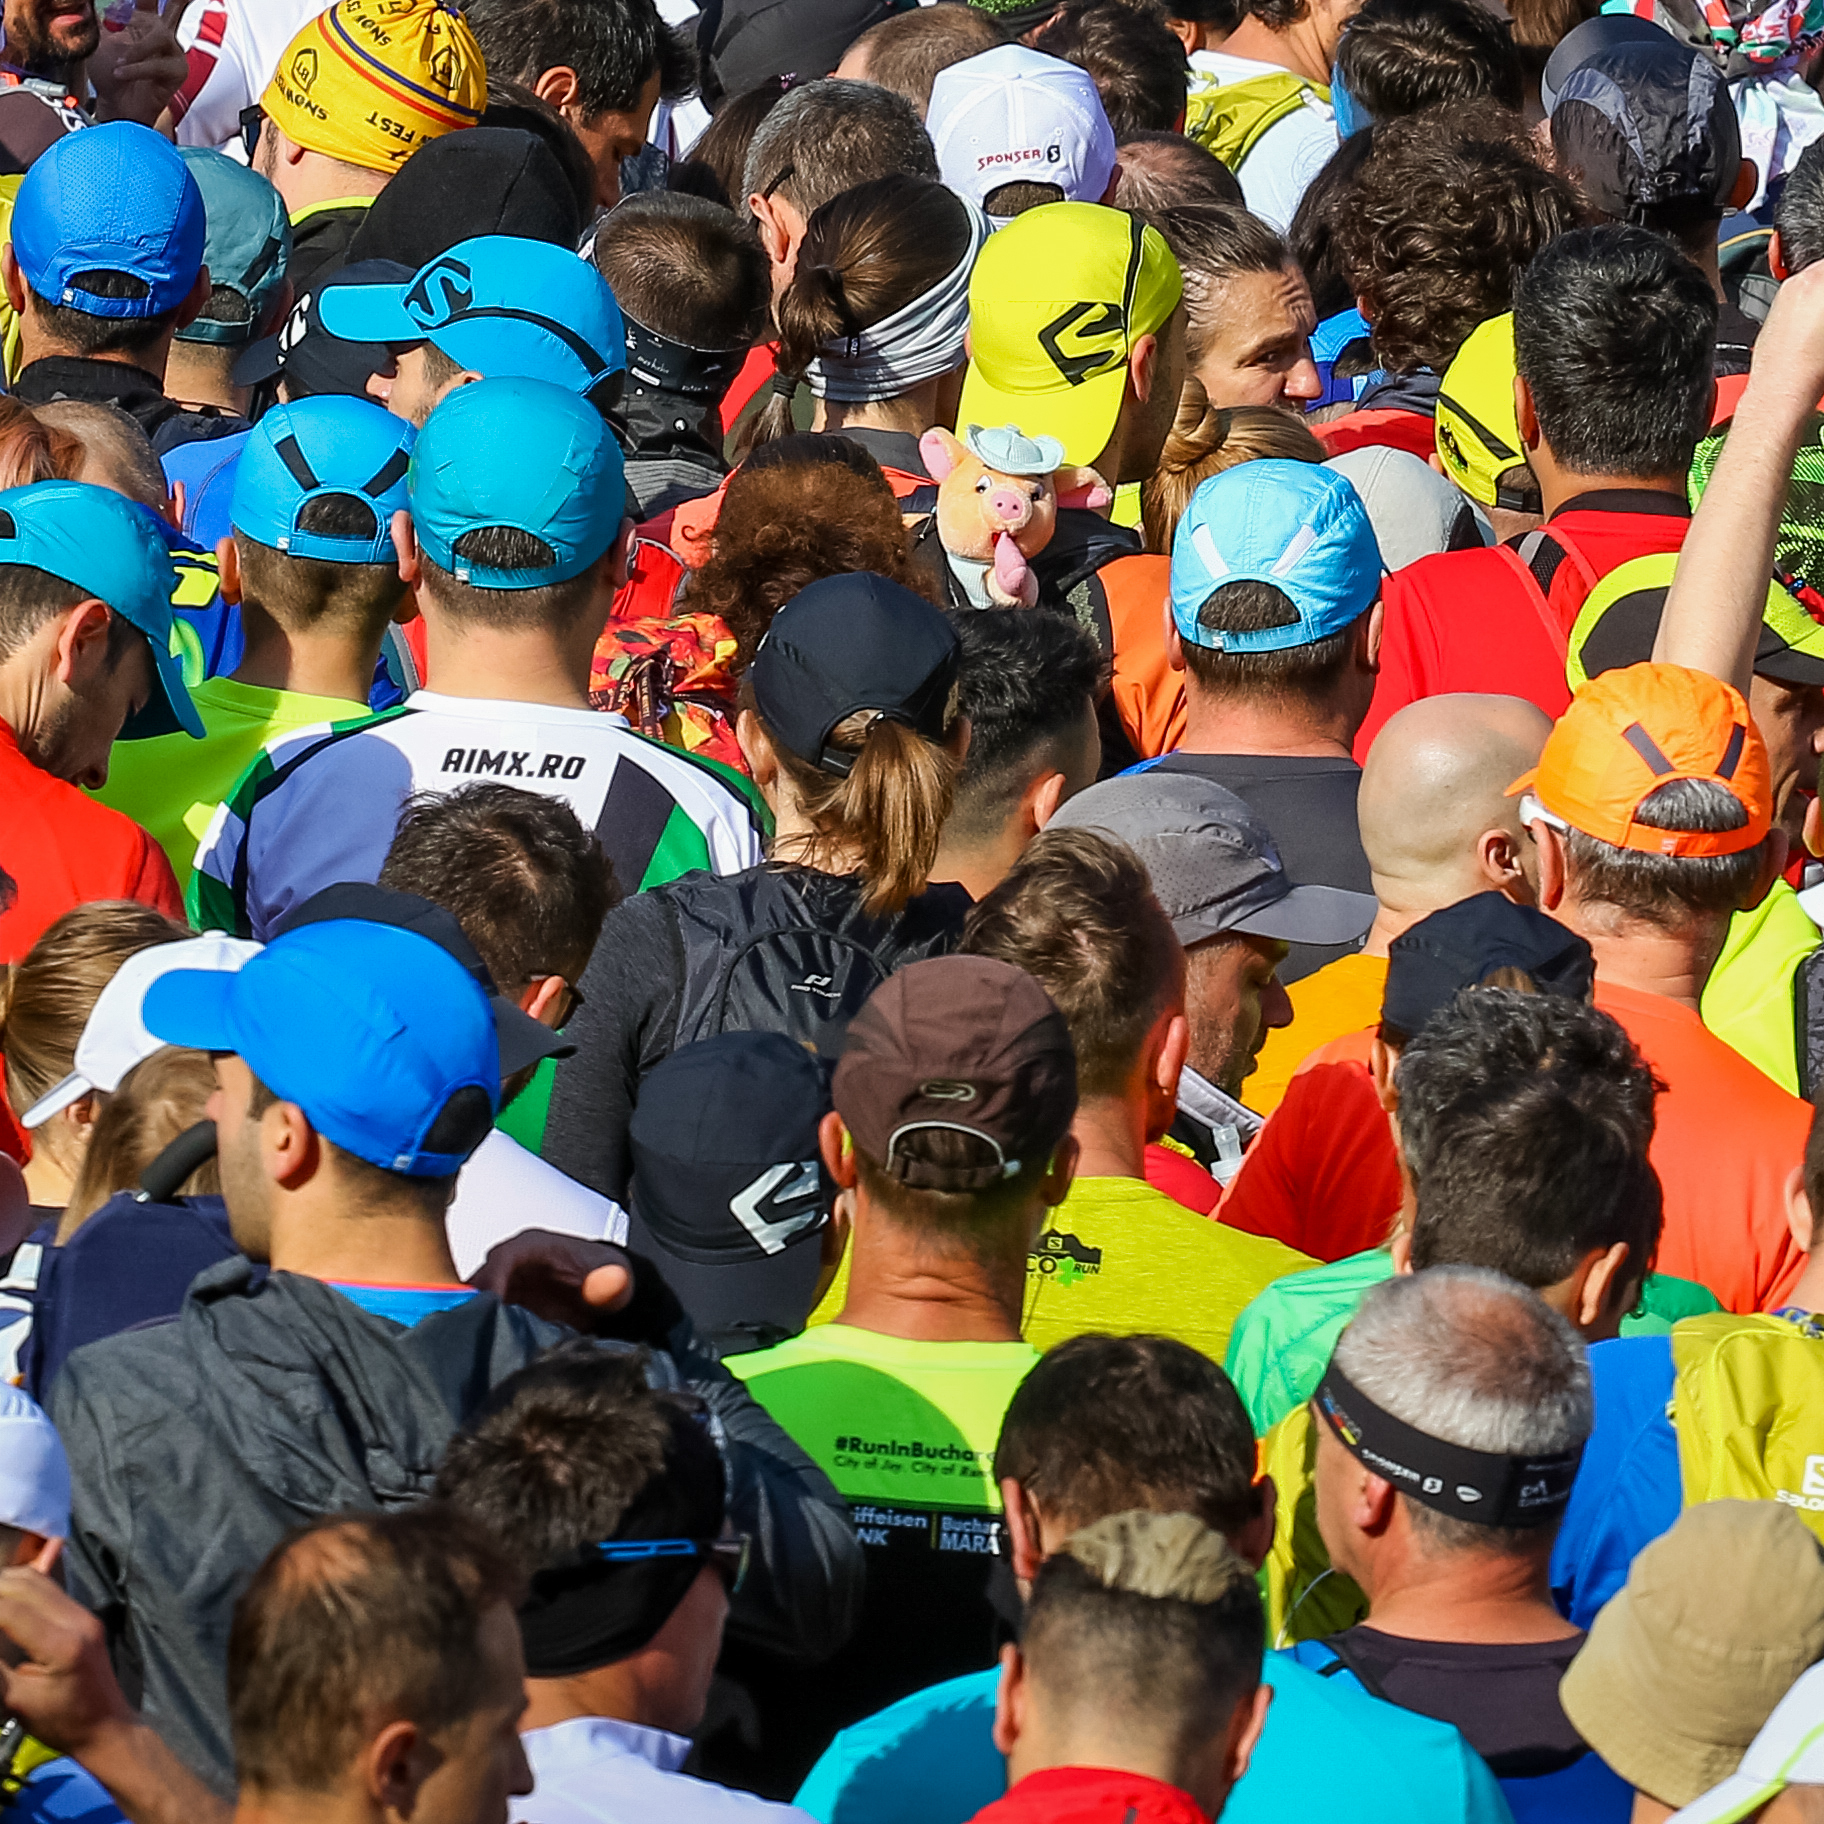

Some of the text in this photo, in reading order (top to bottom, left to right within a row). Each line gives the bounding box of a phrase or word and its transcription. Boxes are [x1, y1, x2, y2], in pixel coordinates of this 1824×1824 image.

[976, 147, 1041, 172] SPONSER
[440, 747, 587, 781] AIMX.RO
[1073, 1263, 1101, 1275] RUN
[834, 1455, 860, 1469] City
[911, 1461, 937, 1474] City
